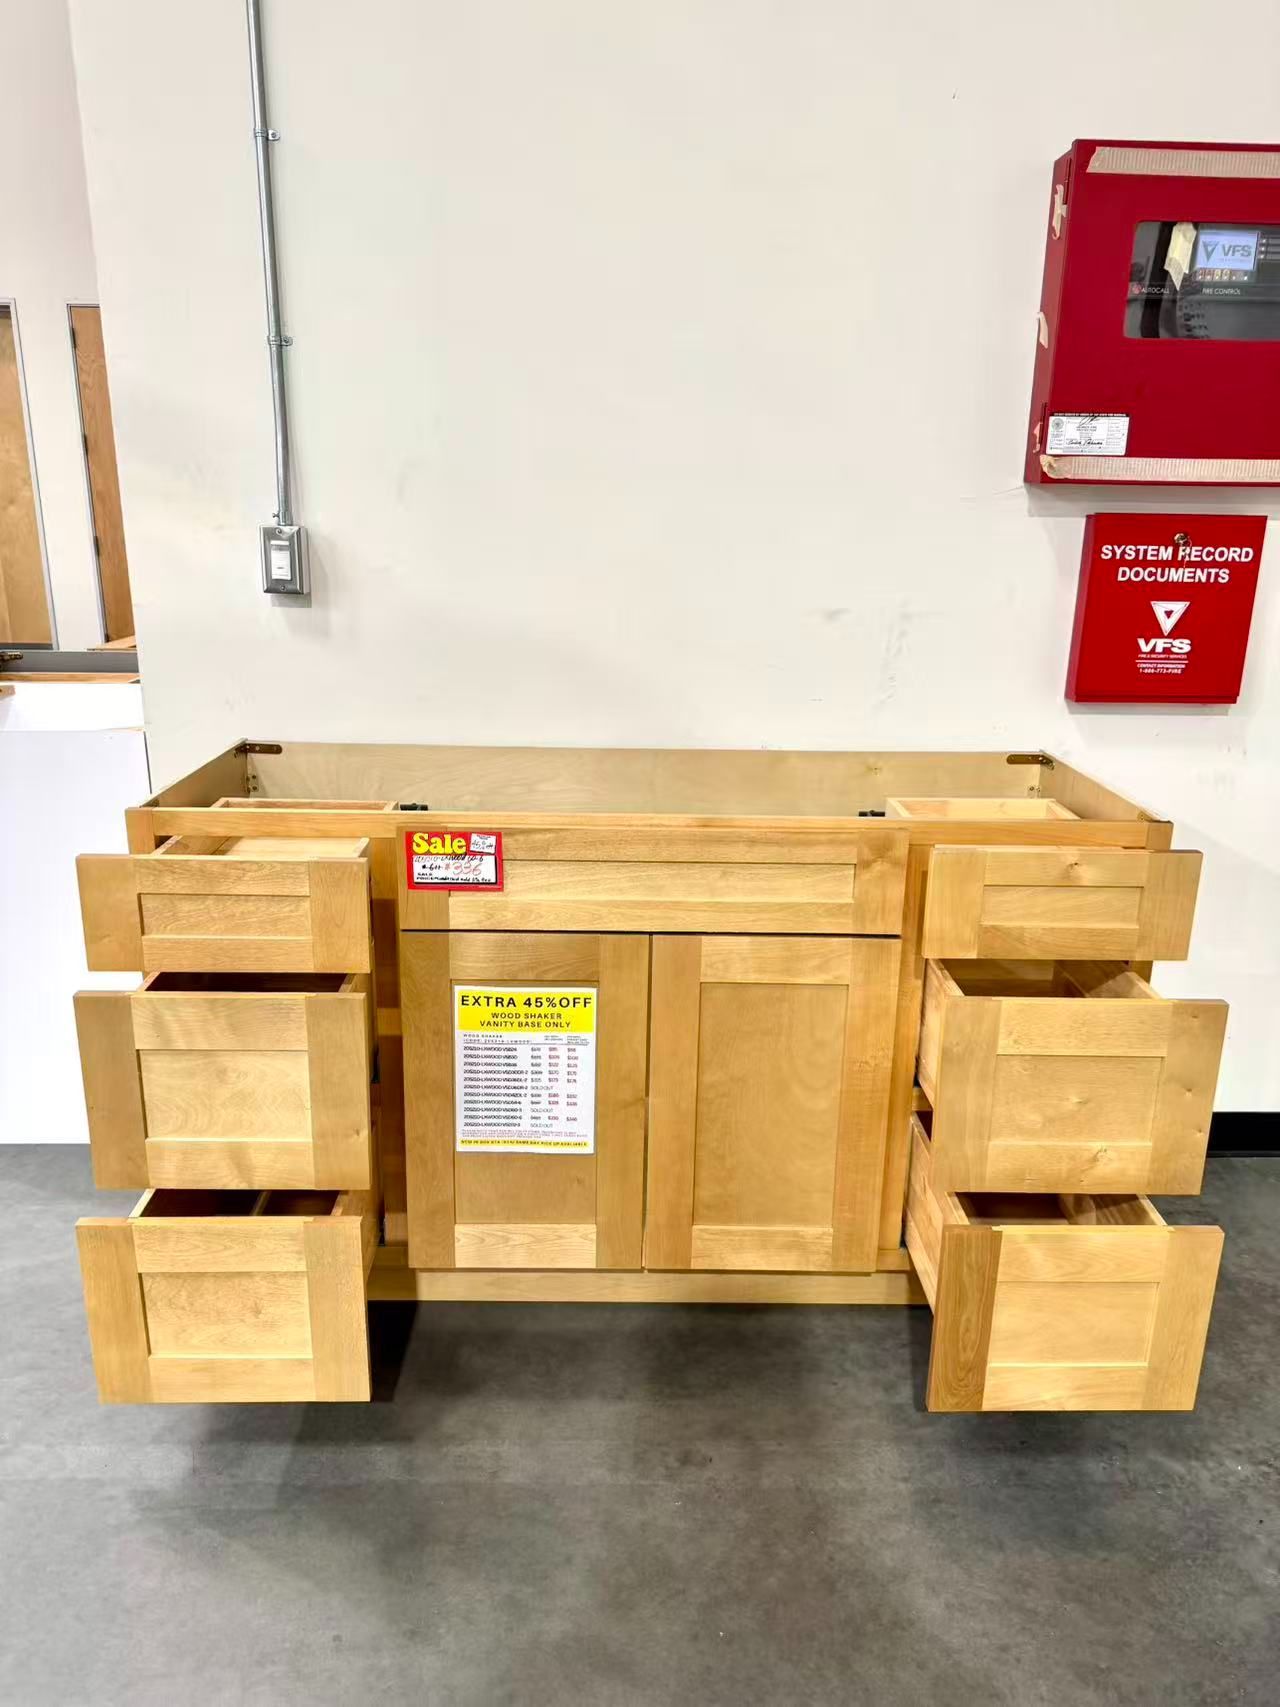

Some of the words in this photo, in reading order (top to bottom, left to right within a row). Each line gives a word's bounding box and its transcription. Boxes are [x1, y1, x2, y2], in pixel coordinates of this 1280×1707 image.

[1222, 244, 1252, 257] VFS
[1100, 545, 1173, 561] SYSTEM
[1177, 546, 1254, 562] RECORD
[1117, 567, 1230, 583] DOCUMENTS
[1137, 638, 1192, 654] VFS
[412, 832, 467, 855] Sale
[461, 995, 517, 1008] EXTRA
[523, 996, 593, 1009] 45%OFF
[479, 1020, 514, 1028] VANITY
